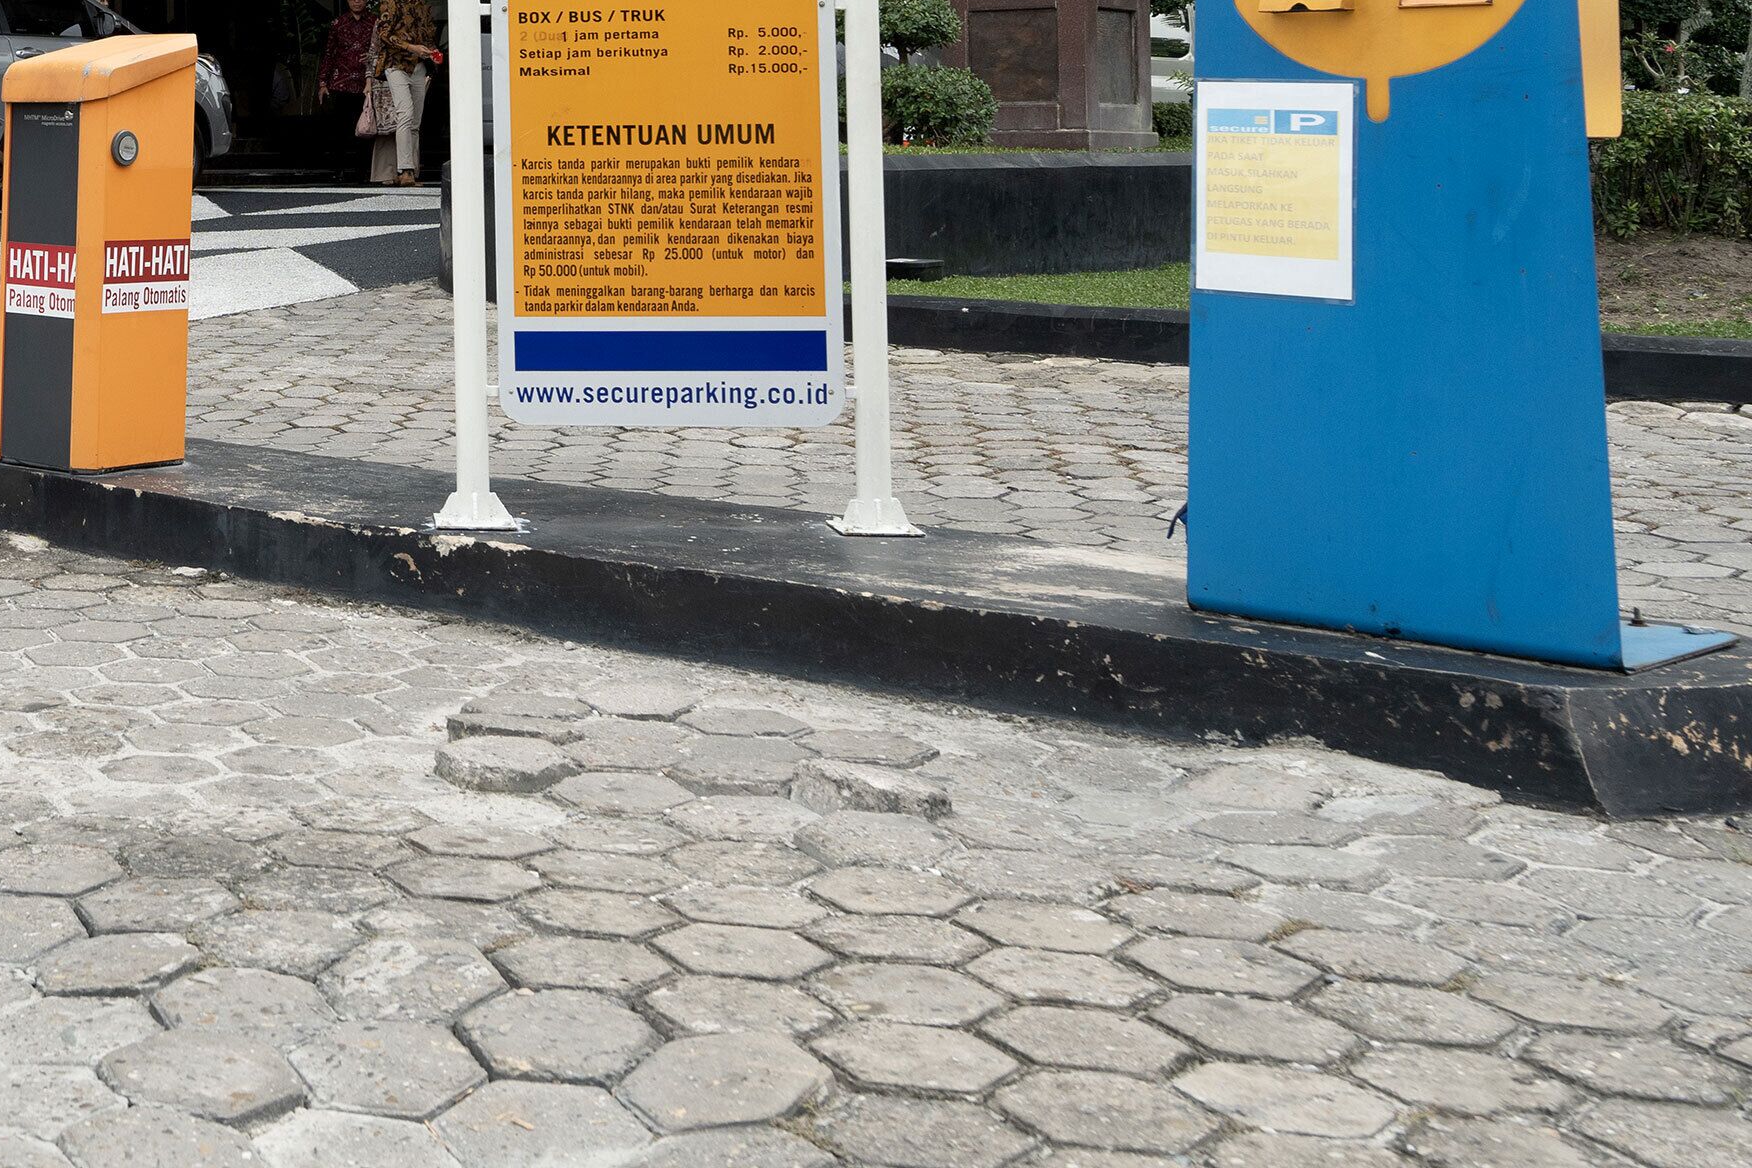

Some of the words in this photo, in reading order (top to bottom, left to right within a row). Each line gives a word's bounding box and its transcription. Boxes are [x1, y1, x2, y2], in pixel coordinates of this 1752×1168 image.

[518, 11, 551, 24] BOX
[568, 10, 602, 23] BUS
[619, 9, 666, 22] TRUK
[574, 29, 599, 43] jam
[604, 30, 659, 42] pertama
[727, 27, 749, 41] Rp.
[519, 48, 562, 61] Setiap
[566, 47, 592, 61] jam
[596, 46, 668, 60] berikutnya
[728, 45, 749, 58] Rp.
[758, 44, 808, 57] 2.000,-
[519, 65, 590, 77] Maksimal
[1209, 125, 1268, 133] secure
[1290, 113, 1326, 132] P
[547, 124, 687, 147] KETENTUAN
[697, 123, 775, 145] UMUM
[521, 157, 553, 170] Karcis
[557, 158, 585, 170] tanda
[590, 157, 621, 173] parkir
[625, 157, 681, 172] merupakan
[685, 156, 711, 169] bukti
[716, 155, 754, 172] pemilik
[521, 172, 579, 186] memarkirkan
[581, 172, 643, 187] kendaraannya
[644, 172, 654, 185] di
[655, 174, 677, 185] area
[679, 171, 708, 186] parkir
[710, 174, 734, 186] yang
[735, 171, 791, 184] disediakan.
[793, 171, 813, 184] Jika
[522, 187, 554, 201] karcis
[556, 187, 584, 200] tanda
[587, 187, 617, 202] parkir
[620, 187, 655, 202] hilang,
[658, 187, 685, 200] maka
[688, 187, 726, 202] pemilik
[729, 186, 782, 199] kendaraan
[785, 186, 813, 201] wajib
[523, 202, 602, 217] memperlihatkan
[607, 202, 635, 215] STNK
[640, 202, 684, 215] dan/atau
[689, 202, 717, 215] Surat
[722, 202, 780, 216] Keterangan
[785, 200, 813, 214] resmi
[563, 217, 603, 232] sebagai
[607, 217, 632, 230] bukti
[637, 217, 675, 232] pemilik
[679, 217, 732, 230] kendaraan
[736, 217, 762, 230] telah
[765, 216, 814, 230] memarkir
[597, 233, 616, 245] dan
[623, 232, 660, 247] pemilik
[667, 232, 720, 245] kendaraan
[727, 232, 780, 245] dikenakan
[786, 231, 814, 246] biaya
[106, 245, 189, 278] HATI-HATI
[523, 247, 584, 261] administrasi
[593, 248, 633, 261] sebesar
[642, 247, 655, 262] Rp
[664, 247, 704, 261] 25.000
[711, 247, 744, 261] (untuk
[753, 247, 787, 261] motor)
[795, 247, 815, 260] dan
[523, 264, 536, 280] Rp
[538, 264, 578, 278] 50.000
[578, 264, 611, 278] (untuk
[613, 263, 649, 278] mobil).
[104, 288, 141, 310] Palang
[143, 284, 187, 305] Otomatis
[523, 284, 551, 297] Tidak
[556, 284, 625, 300] meninggalkan
[630, 284, 704, 300] barang-barang
[709, 284, 754, 300] berharga
[759, 284, 779, 297] dan
[783, 283, 816, 297] karcis
[9, 288, 46, 314] Palang
[524, 300, 552, 313] tanda
[553, 299, 584, 315] parkir
[584, 300, 615, 312] dalam
[616, 299, 671, 312] kendaraan
[670, 299, 700, 312] Anda.
[516, 381, 828, 410] www.secureparking.co.id
